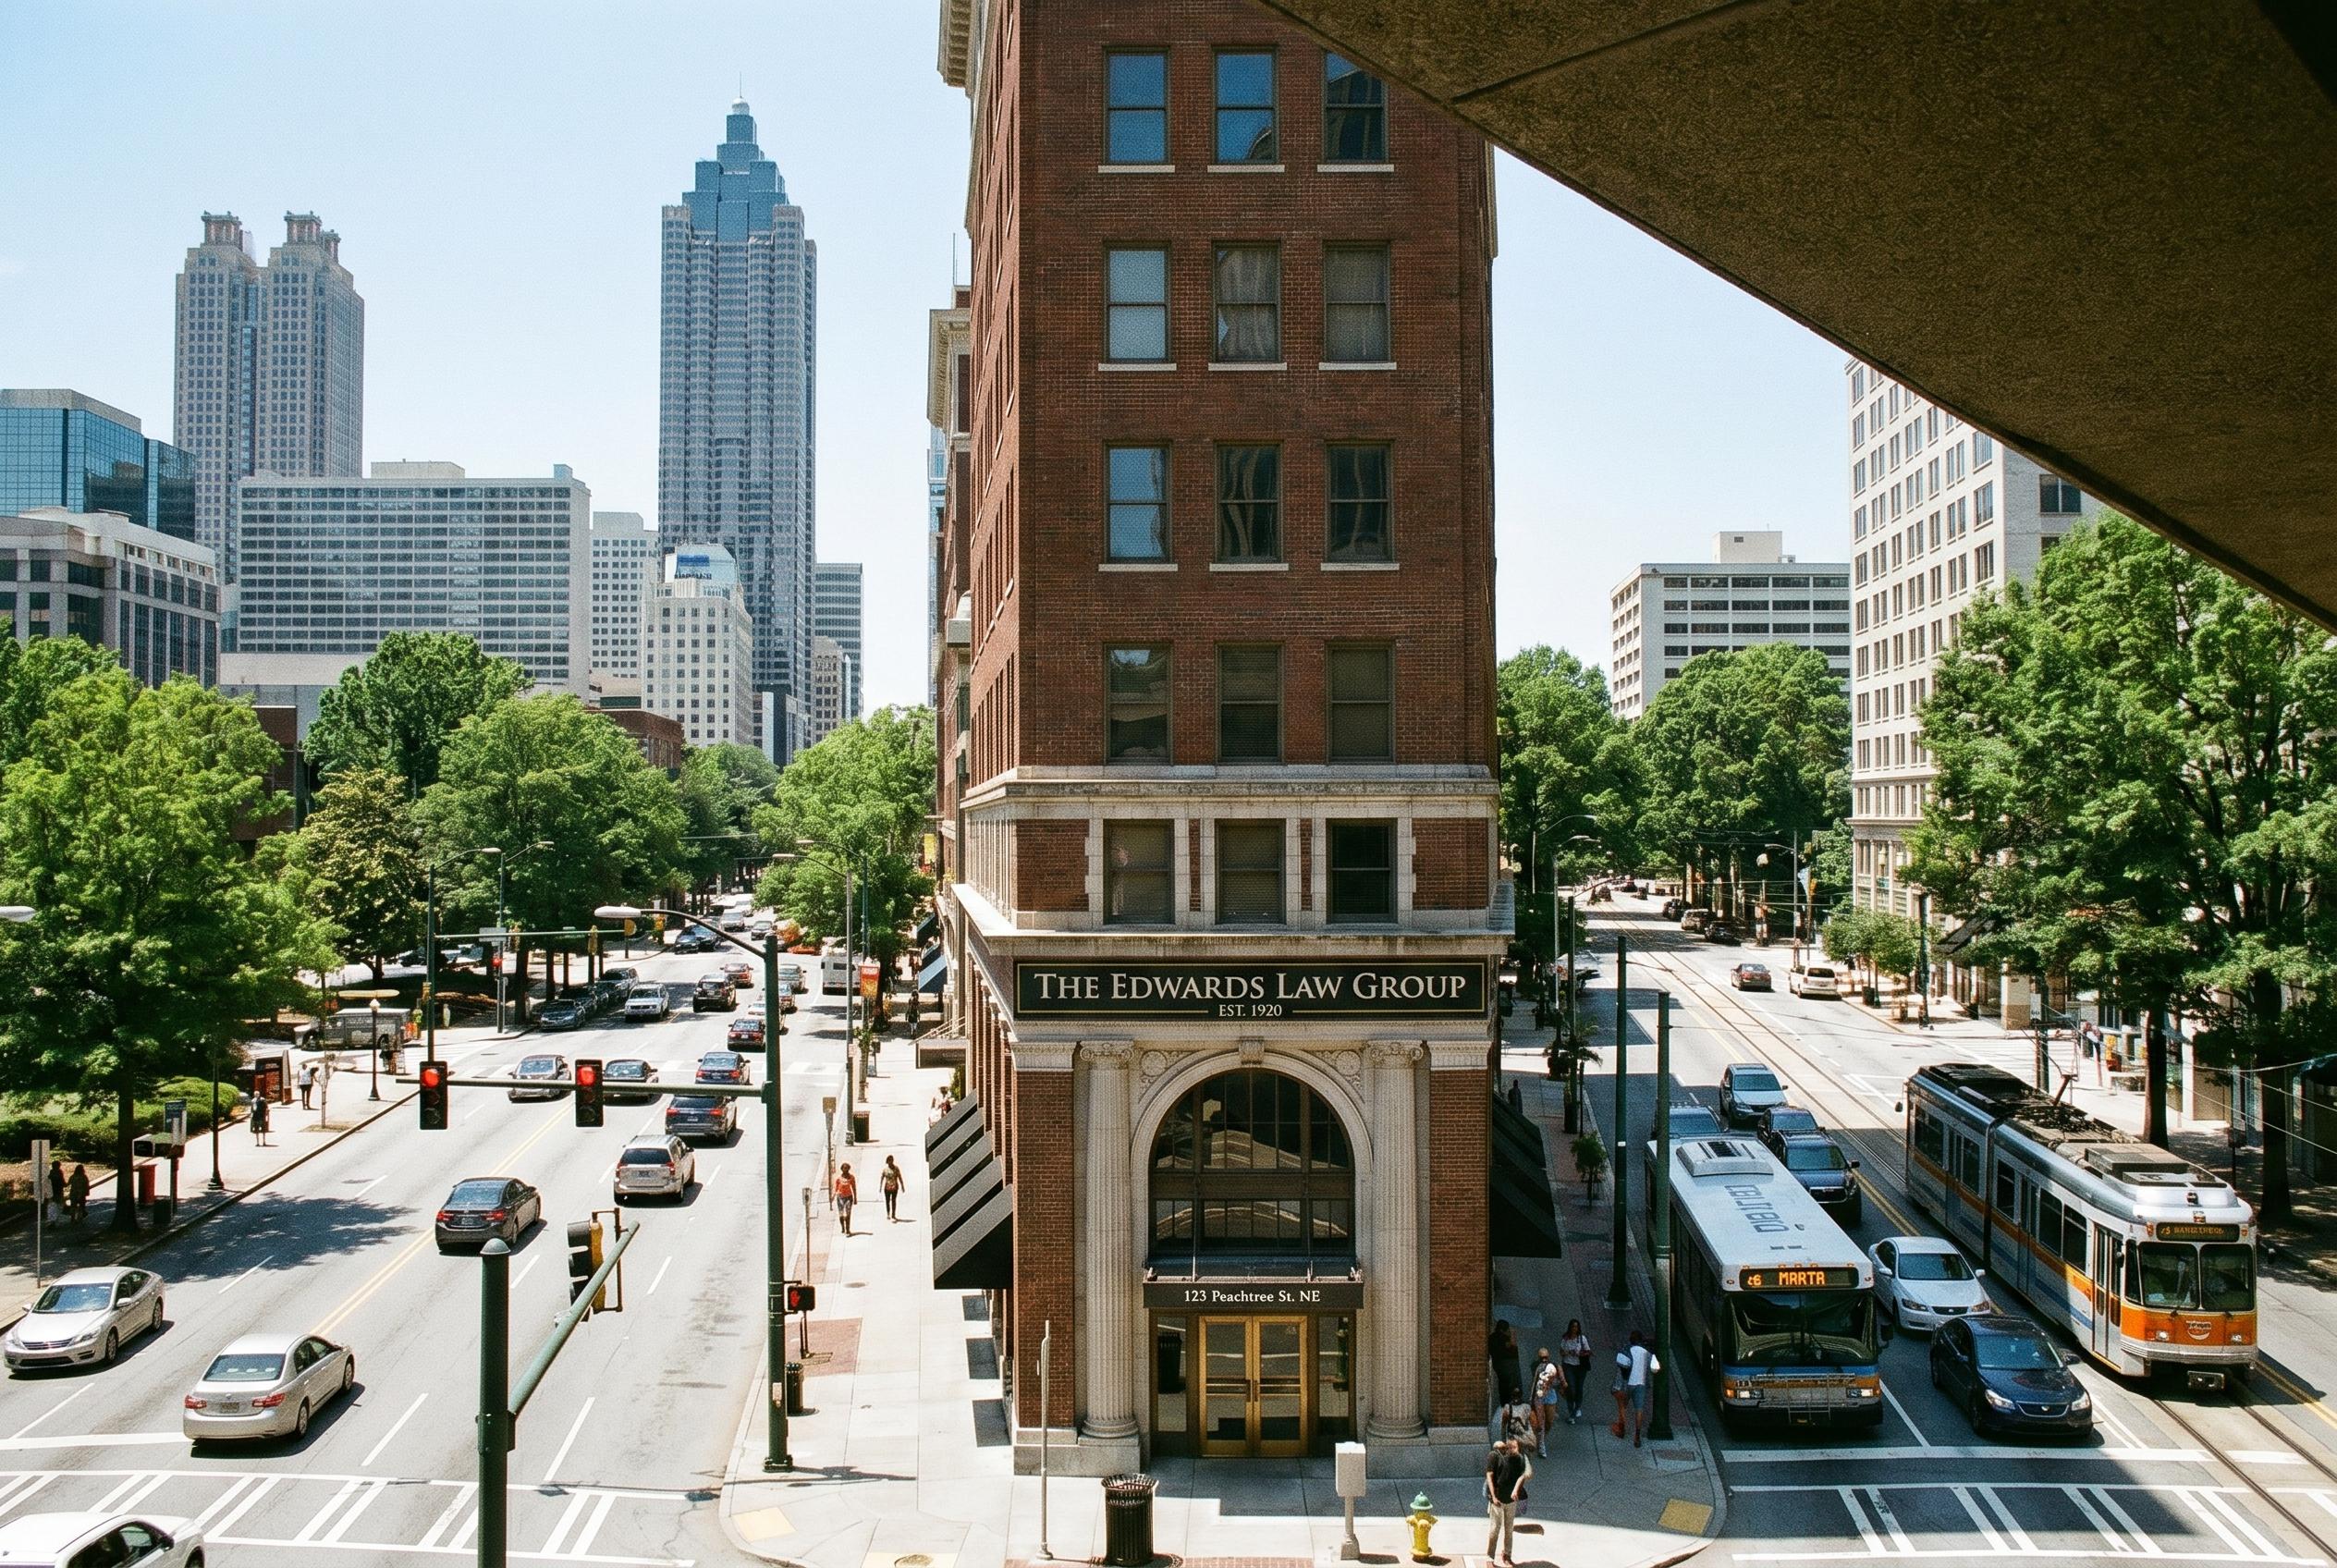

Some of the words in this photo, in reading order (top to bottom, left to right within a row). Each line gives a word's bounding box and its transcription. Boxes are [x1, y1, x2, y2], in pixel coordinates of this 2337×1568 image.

[1034, 973, 1100, 999] THE
[1110, 973, 1265, 999] EDWARDS
[1276, 973, 1344, 999] LAW
[1352, 972, 1466, 999] GROUP
[1218, 1004, 1246, 1017] EST.
[1251, 1004, 1283, 1017] 1920
[1184, 1290, 1207, 1302] 123
[1211, 1290, 1274, 1303] Peachtree
[1279, 1290, 1295, 1303] St.
[1299, 1290, 1321, 1303] NE
